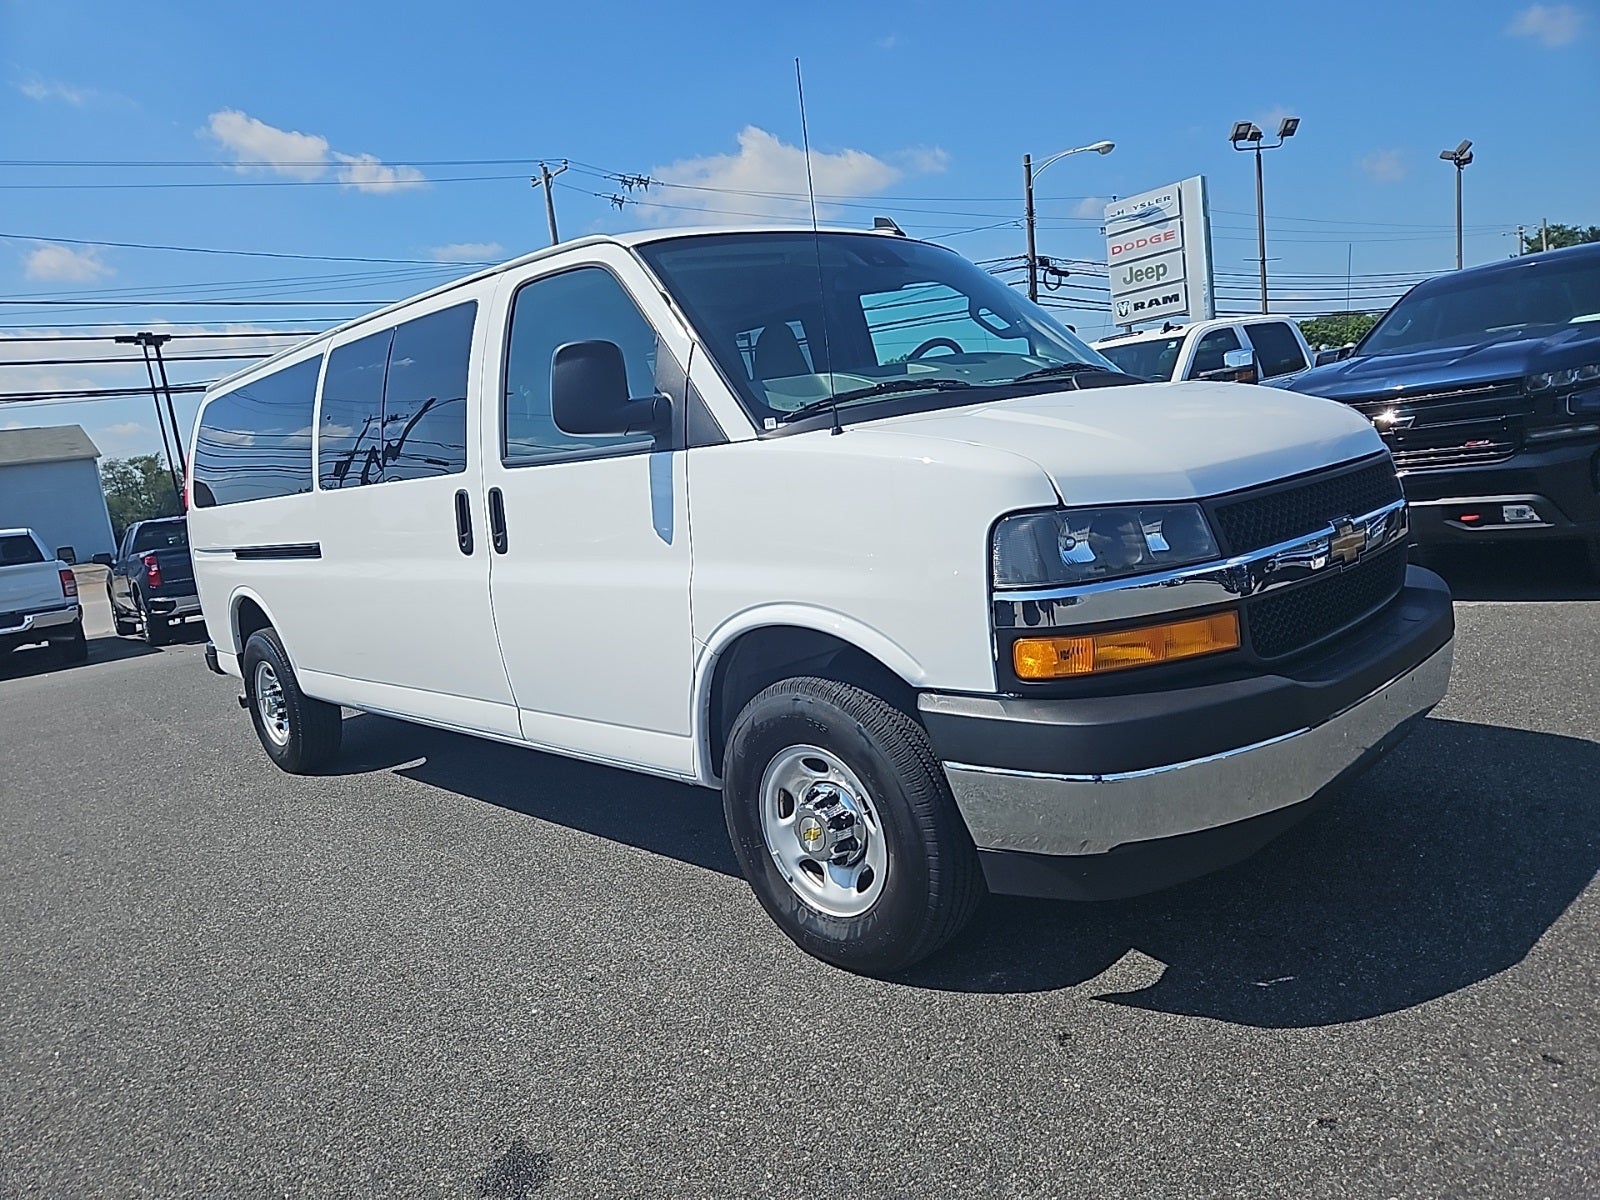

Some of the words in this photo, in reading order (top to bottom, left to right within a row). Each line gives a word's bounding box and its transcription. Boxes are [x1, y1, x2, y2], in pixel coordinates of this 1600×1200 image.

[1110, 195, 1171, 217] HYSLER
[1111, 230, 1176, 256] DODGE
[1123, 263, 1168, 285] Jeep
[1133, 293, 1180, 312] RAM
